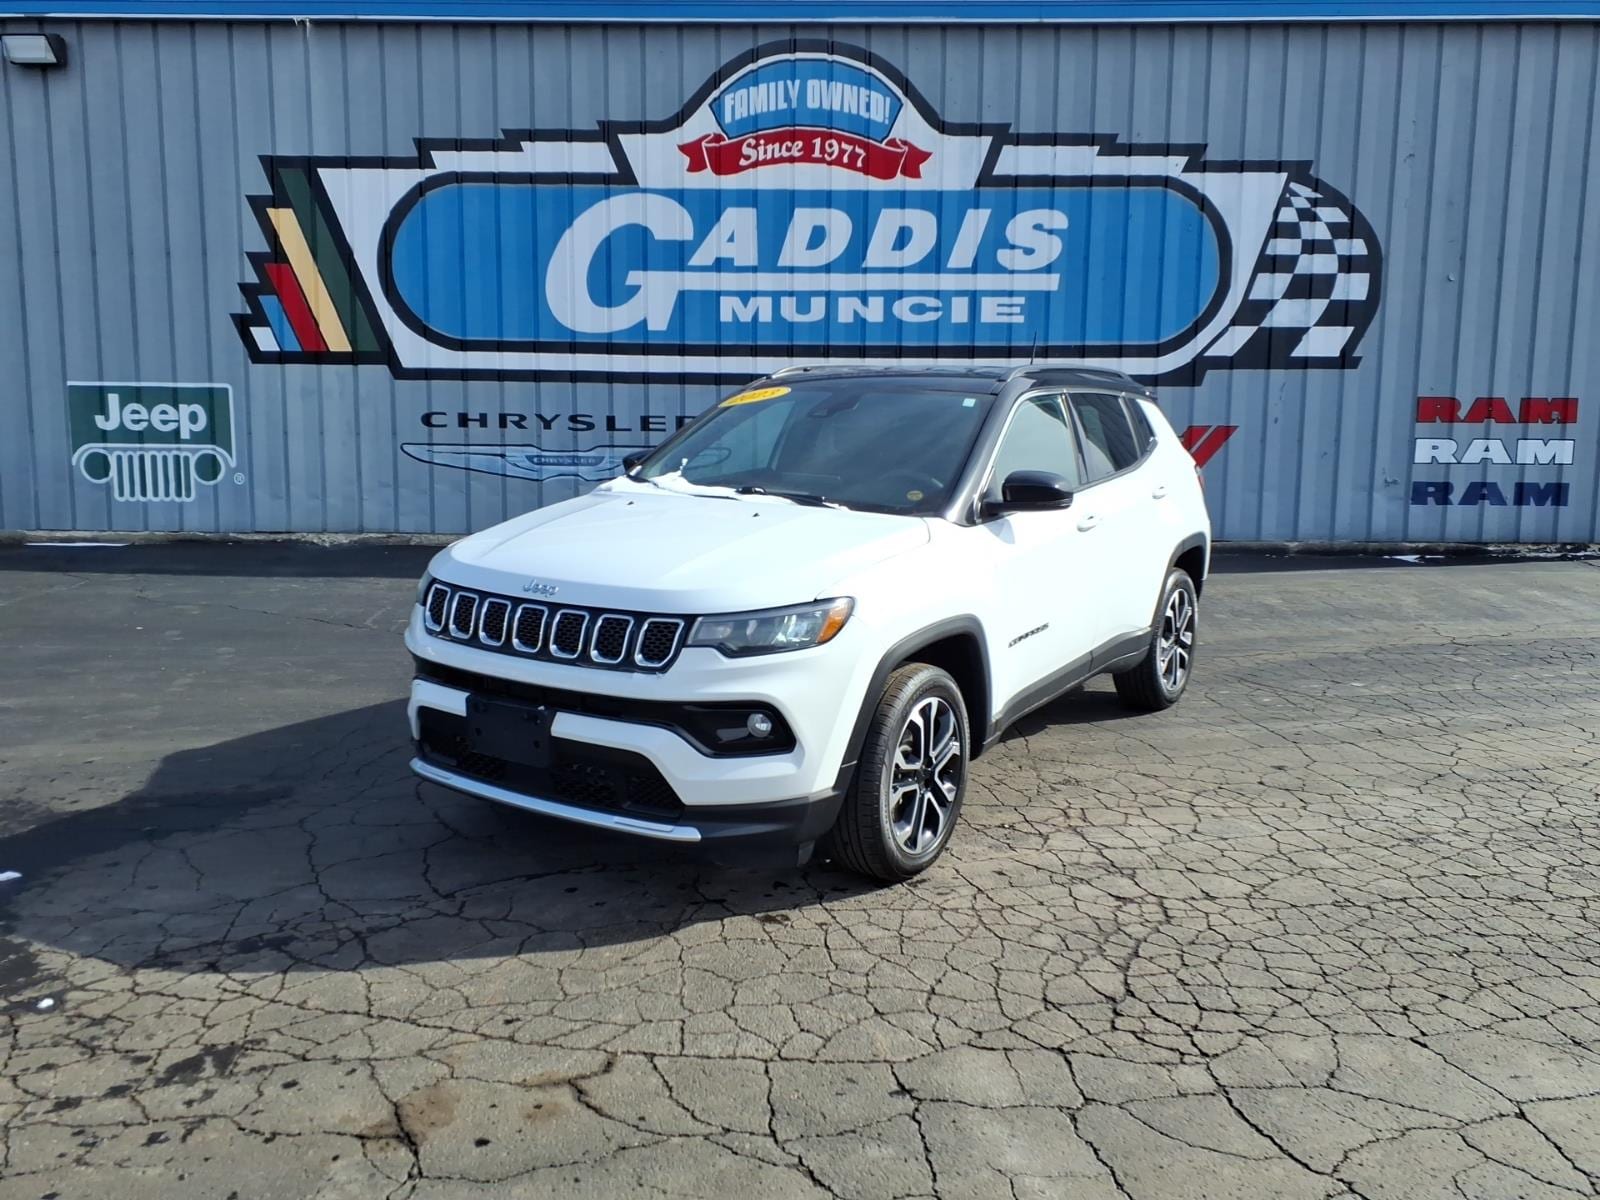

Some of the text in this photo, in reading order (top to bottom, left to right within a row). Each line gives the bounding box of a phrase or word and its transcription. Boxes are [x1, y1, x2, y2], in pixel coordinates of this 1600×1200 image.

[724, 79, 891, 124] FAMILY OWNED!
[738, 137, 867, 168] Since 1977
[545, 193, 1069, 334] GADDIS
[719, 296, 1026, 323] MUNCIE
[94, 393, 207, 440] Jeep
[1416, 396, 1579, 424] RAM
[1413, 438, 1576, 465] RAM
[1411, 481, 1570, 507] RAM
[523, 579, 559, 598] Jeep
